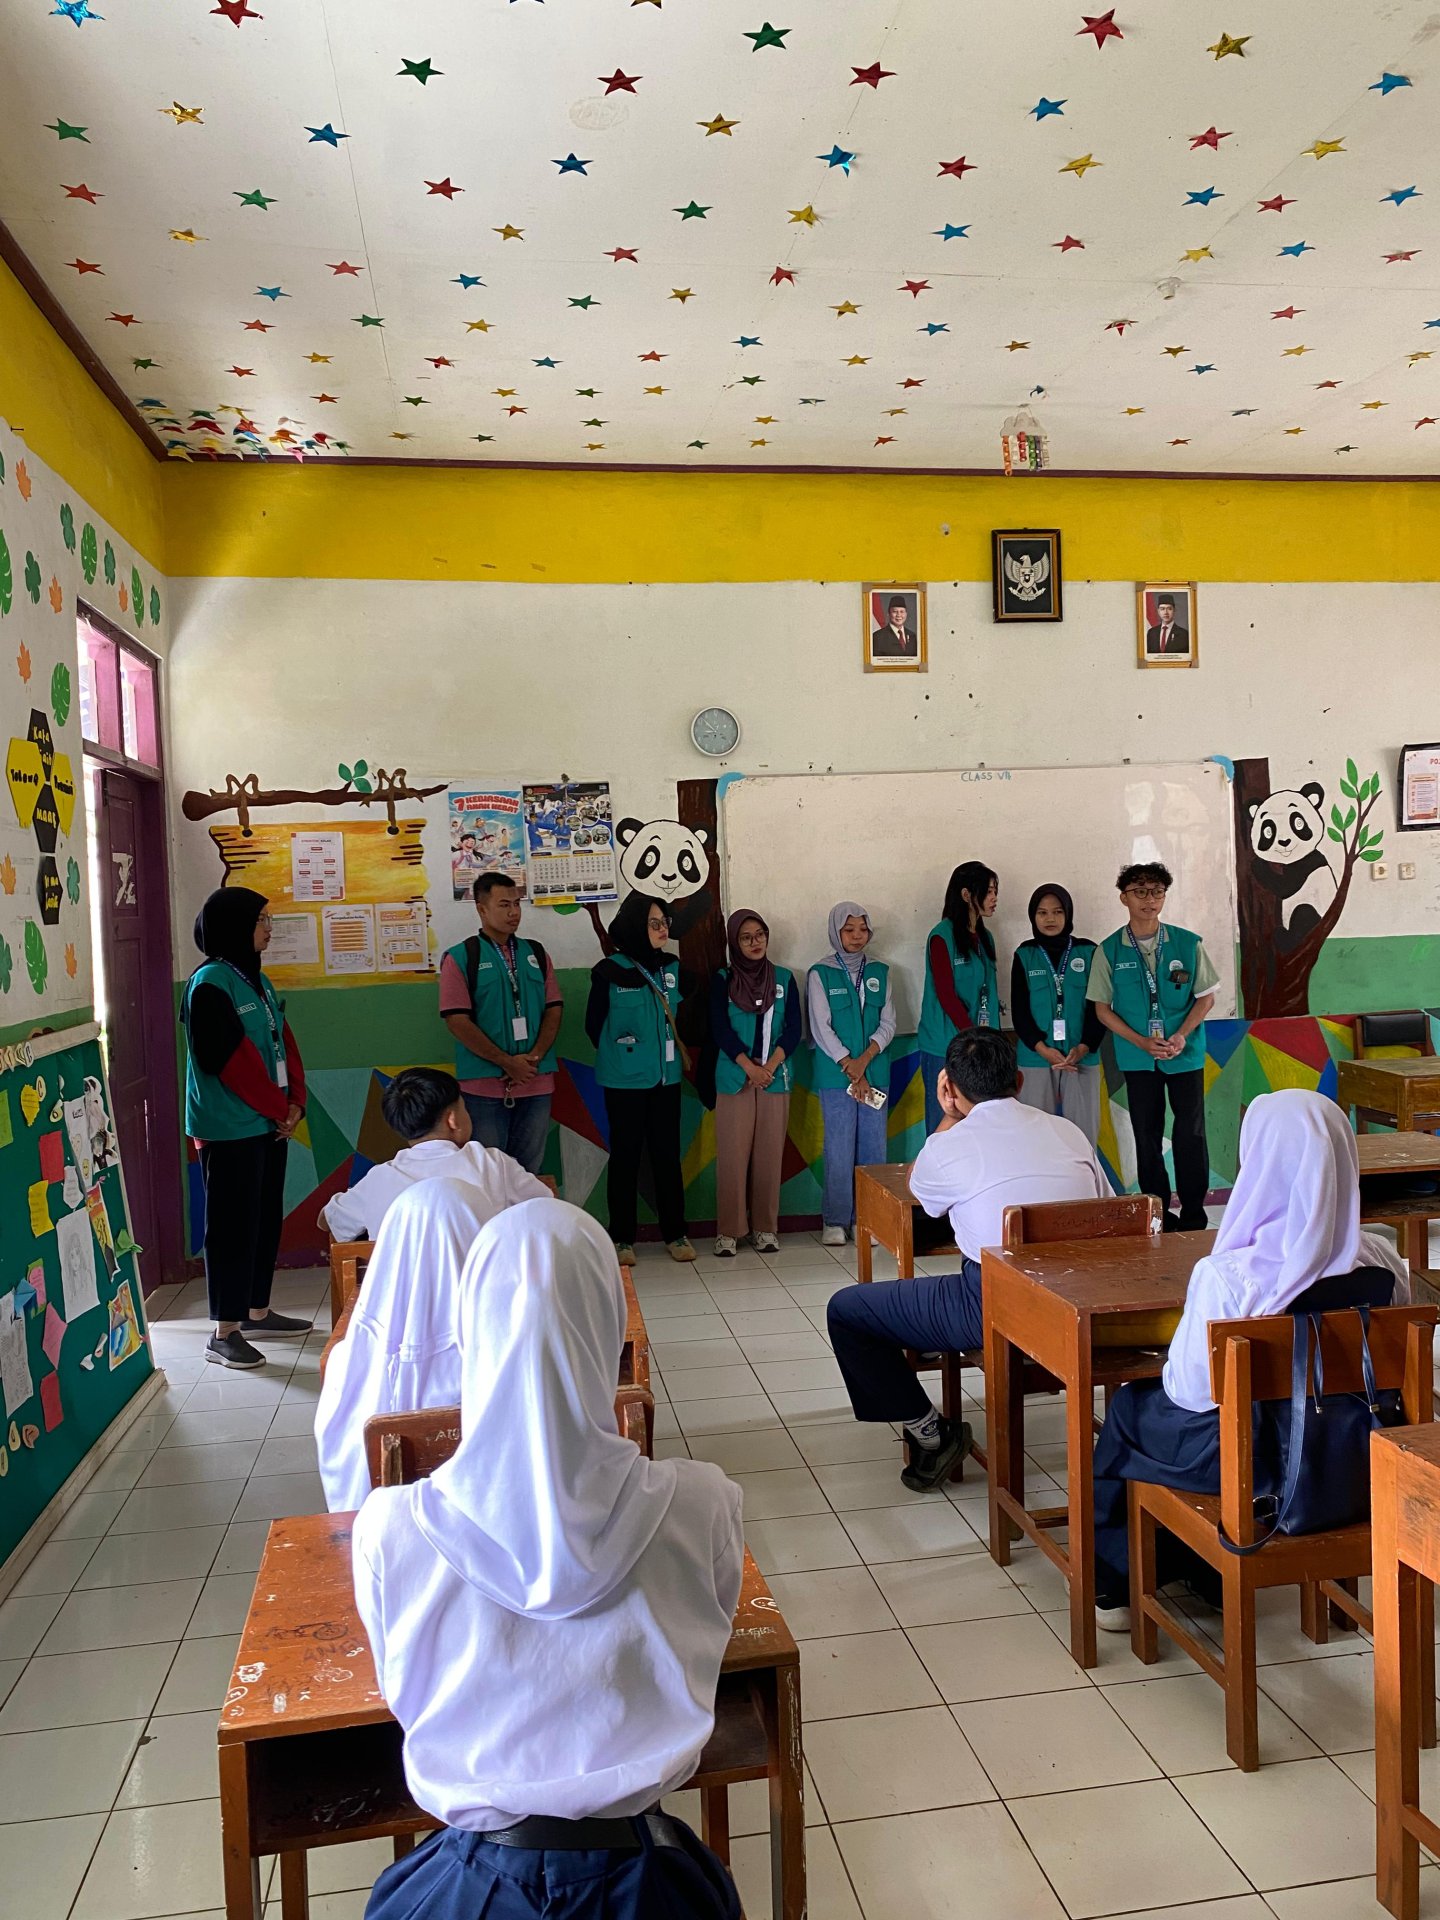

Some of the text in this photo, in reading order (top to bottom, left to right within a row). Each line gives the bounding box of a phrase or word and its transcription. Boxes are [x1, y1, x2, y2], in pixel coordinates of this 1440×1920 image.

[960, 771, 993, 782] CLASS
[453, 797, 465, 812] 7
[465, 795, 519, 807] KEBIASAAN
[466, 803, 519, 814] ANAK HEBAT
